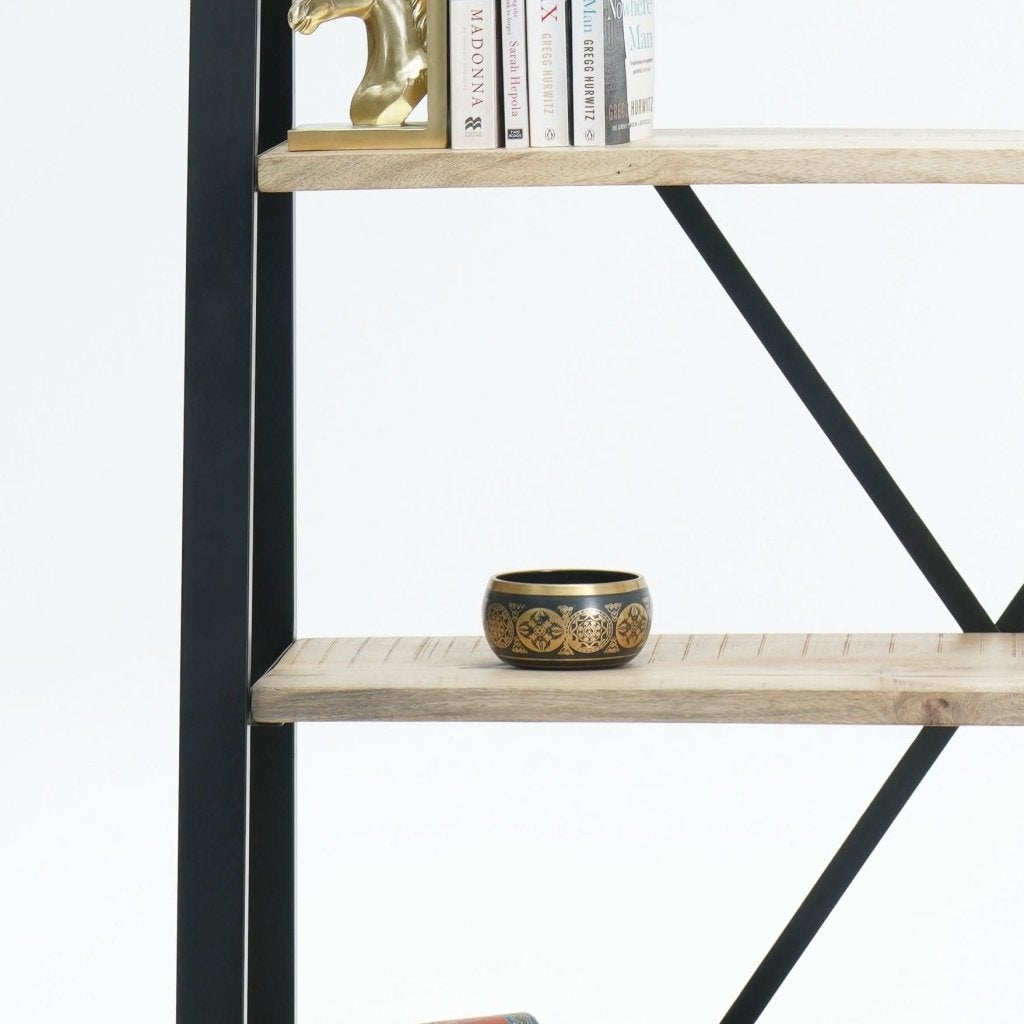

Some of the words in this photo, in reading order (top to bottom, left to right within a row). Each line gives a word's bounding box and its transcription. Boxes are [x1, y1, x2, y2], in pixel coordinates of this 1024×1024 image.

[540, 4, 558, 22] X
[583, 0, 597, 32] Man
[542, 33, 552, 66] GREGG
[630, 25, 653, 51] Man
[470, 9, 484, 107] MADONNA
[508, 40, 520, 72] Sarah
[584, 40, 594, 72] GREGG
[508, 77, 521, 118] Hepola
[542, 70, 554, 114] HURWITZ
[584, 76, 595, 120] HURWITZ
